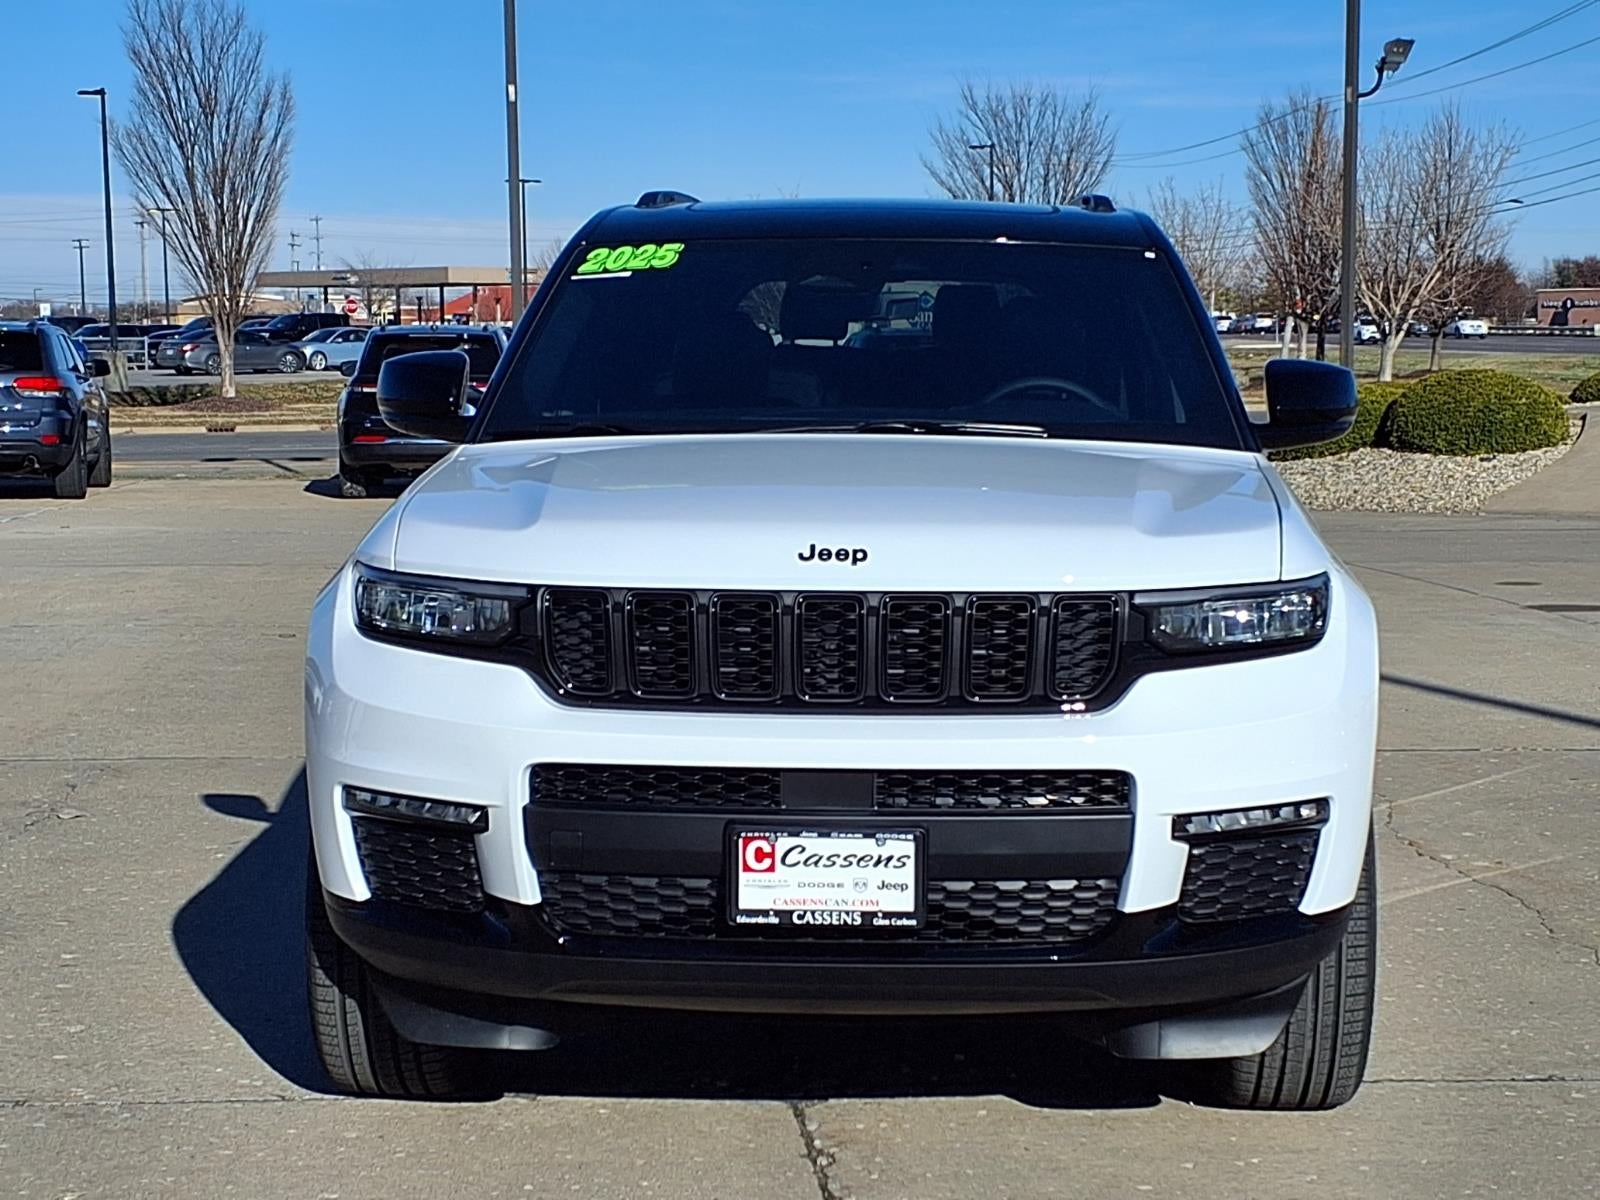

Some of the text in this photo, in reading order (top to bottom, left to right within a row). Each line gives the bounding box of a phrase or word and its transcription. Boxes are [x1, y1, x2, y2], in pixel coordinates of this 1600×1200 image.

[577, 244, 685, 273] 2025
[798, 543, 868, 566] Jeep
[745, 840, 773, 871] C
[780, 844, 911, 869] Cassens
[797, 881, 845, 889] DODGE
[877, 880, 909, 893] Jeep
[773, 898, 880, 907] CASSENSCAN.COM
[792, 911, 862, 926] CASSENS
